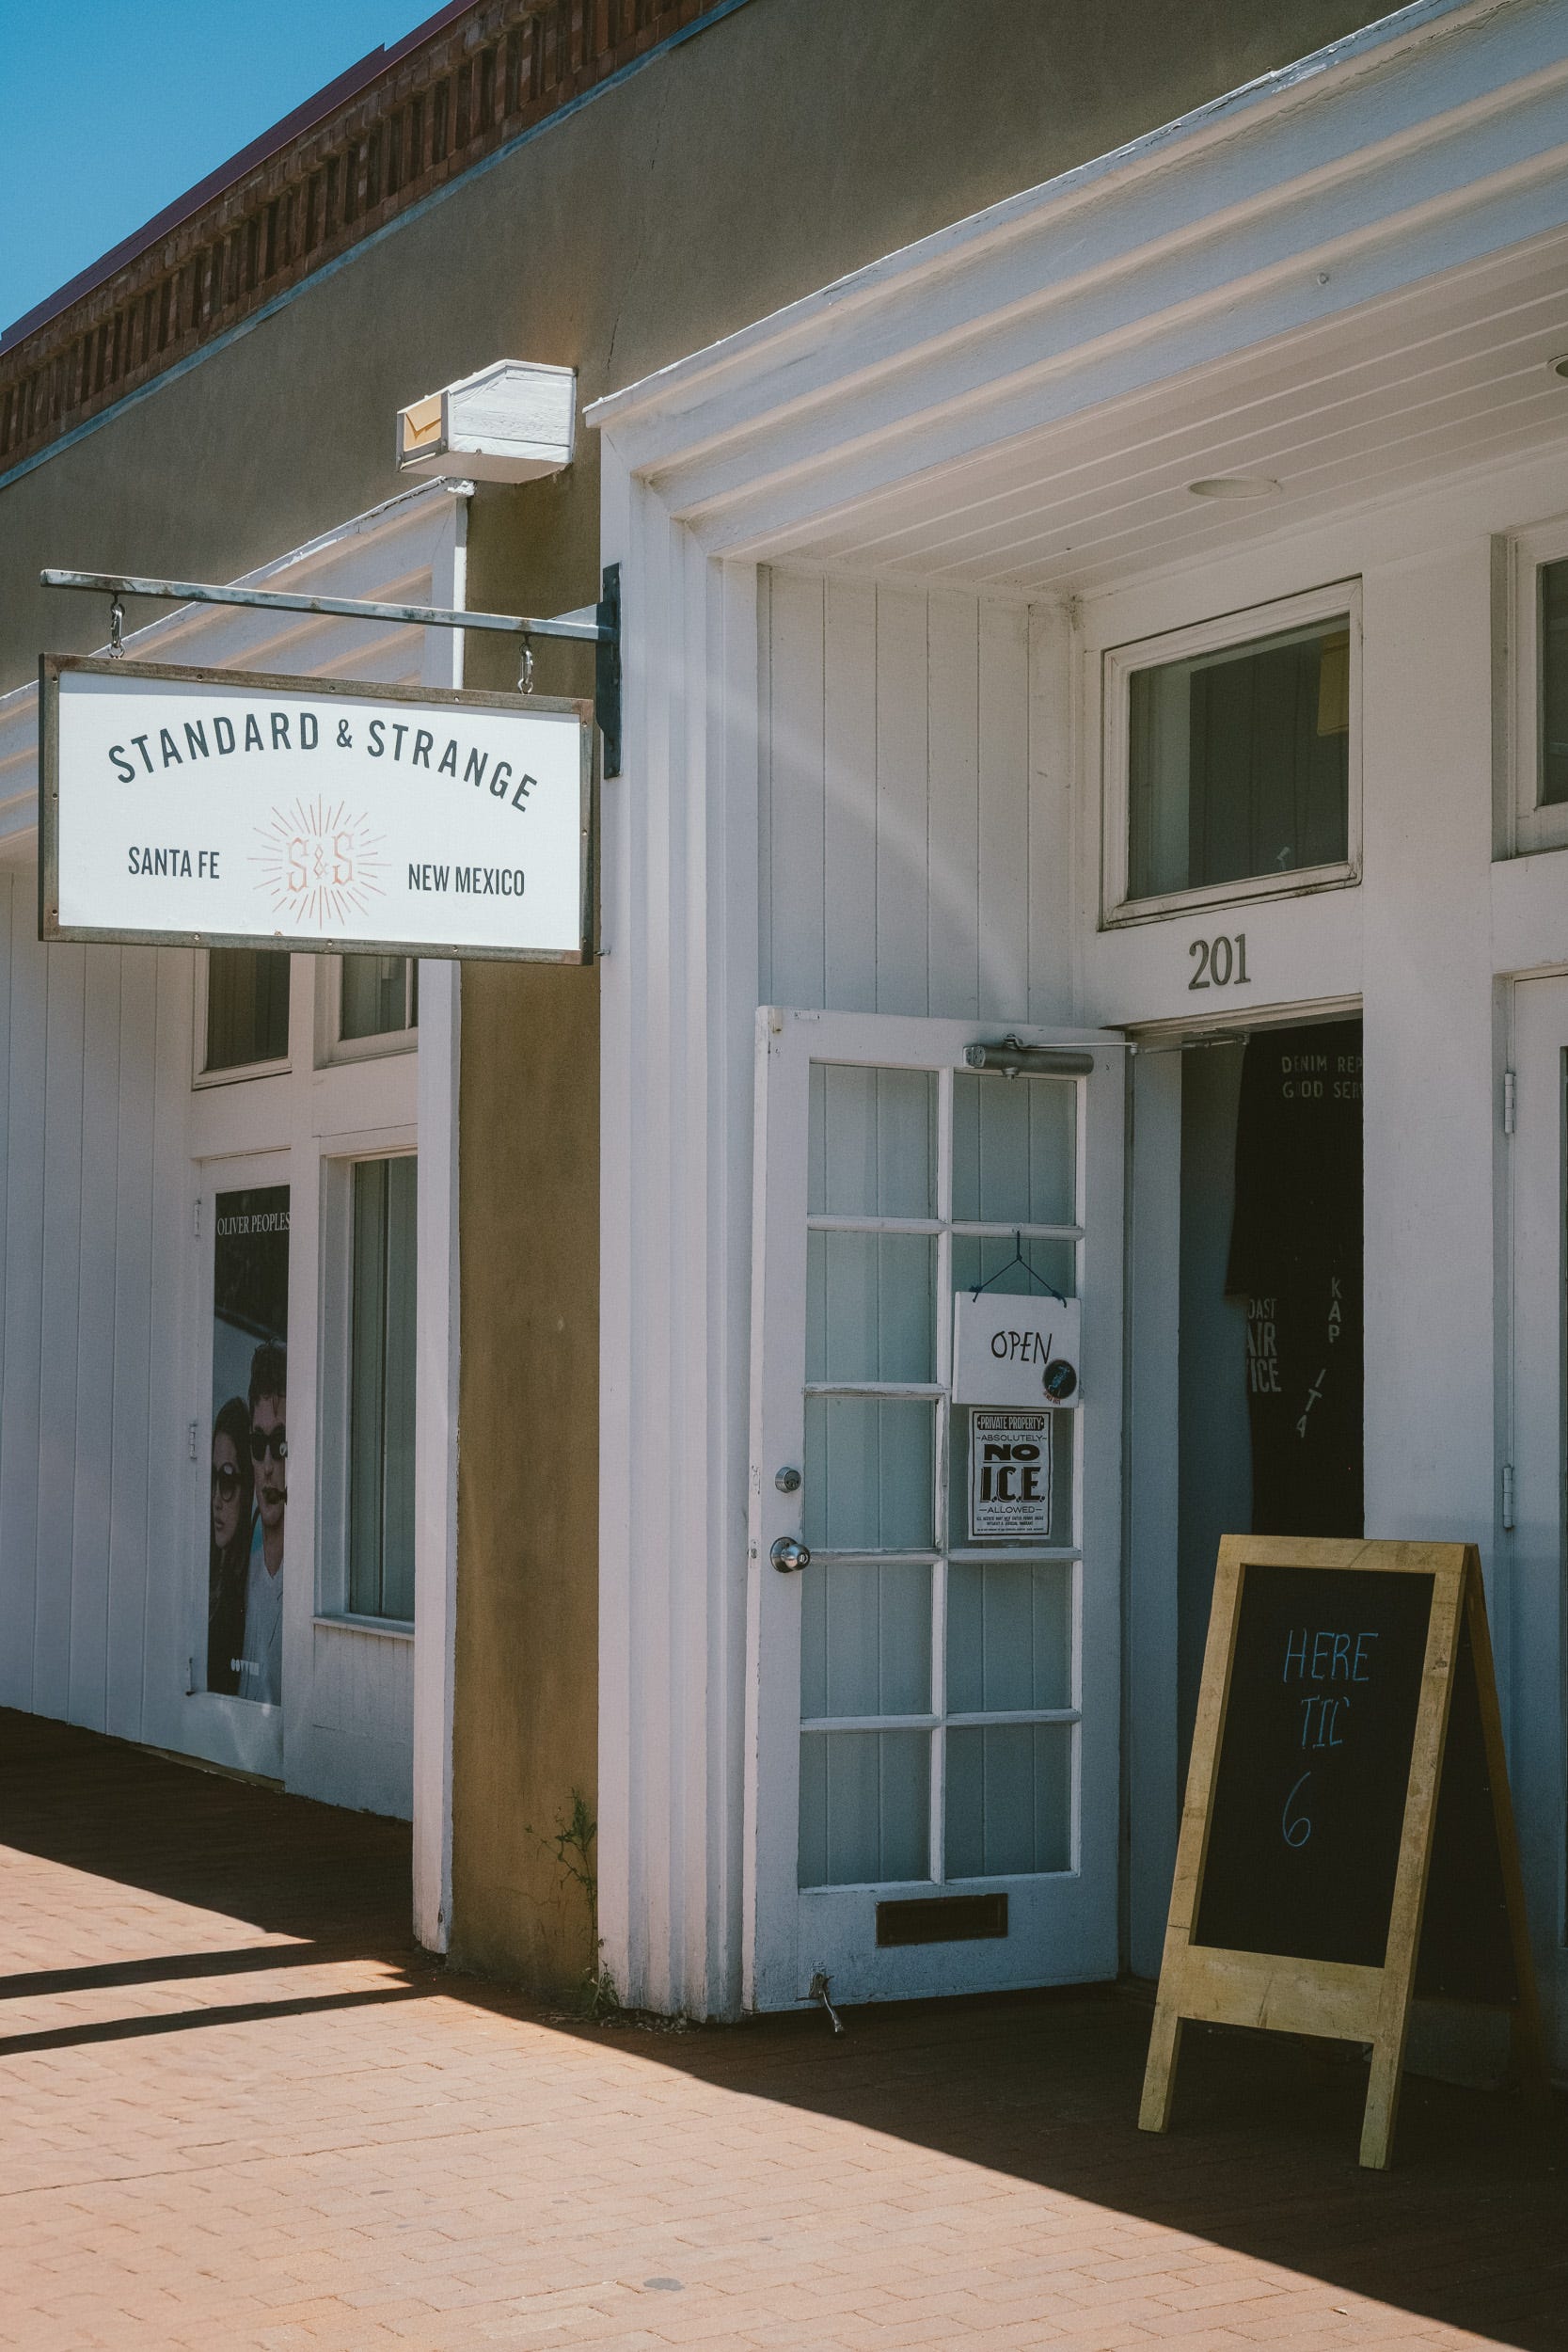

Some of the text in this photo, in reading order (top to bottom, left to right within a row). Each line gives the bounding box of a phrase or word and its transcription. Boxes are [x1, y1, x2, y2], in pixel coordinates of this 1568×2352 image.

[108, 711, 538, 812] STANDARD & STRANGE
[128, 846, 220, 880] SANTA FE
[408, 863, 525, 897] NEW MEXICO
[1188, 933, 1251, 990] 201
[1281, 1055, 1327, 1073] DENIM
[217, 1212, 291, 1235] OLIVER PEOPLES
[991, 1331, 1053, 1364] OPEN
[980, 1416, 1041, 1430] PRIVATE PROPERTY
[984, 1444, 1040, 1461] NO
[1283, 1628, 1379, 1683] HERE
[1282, 1772, 1312, 1848] 6
